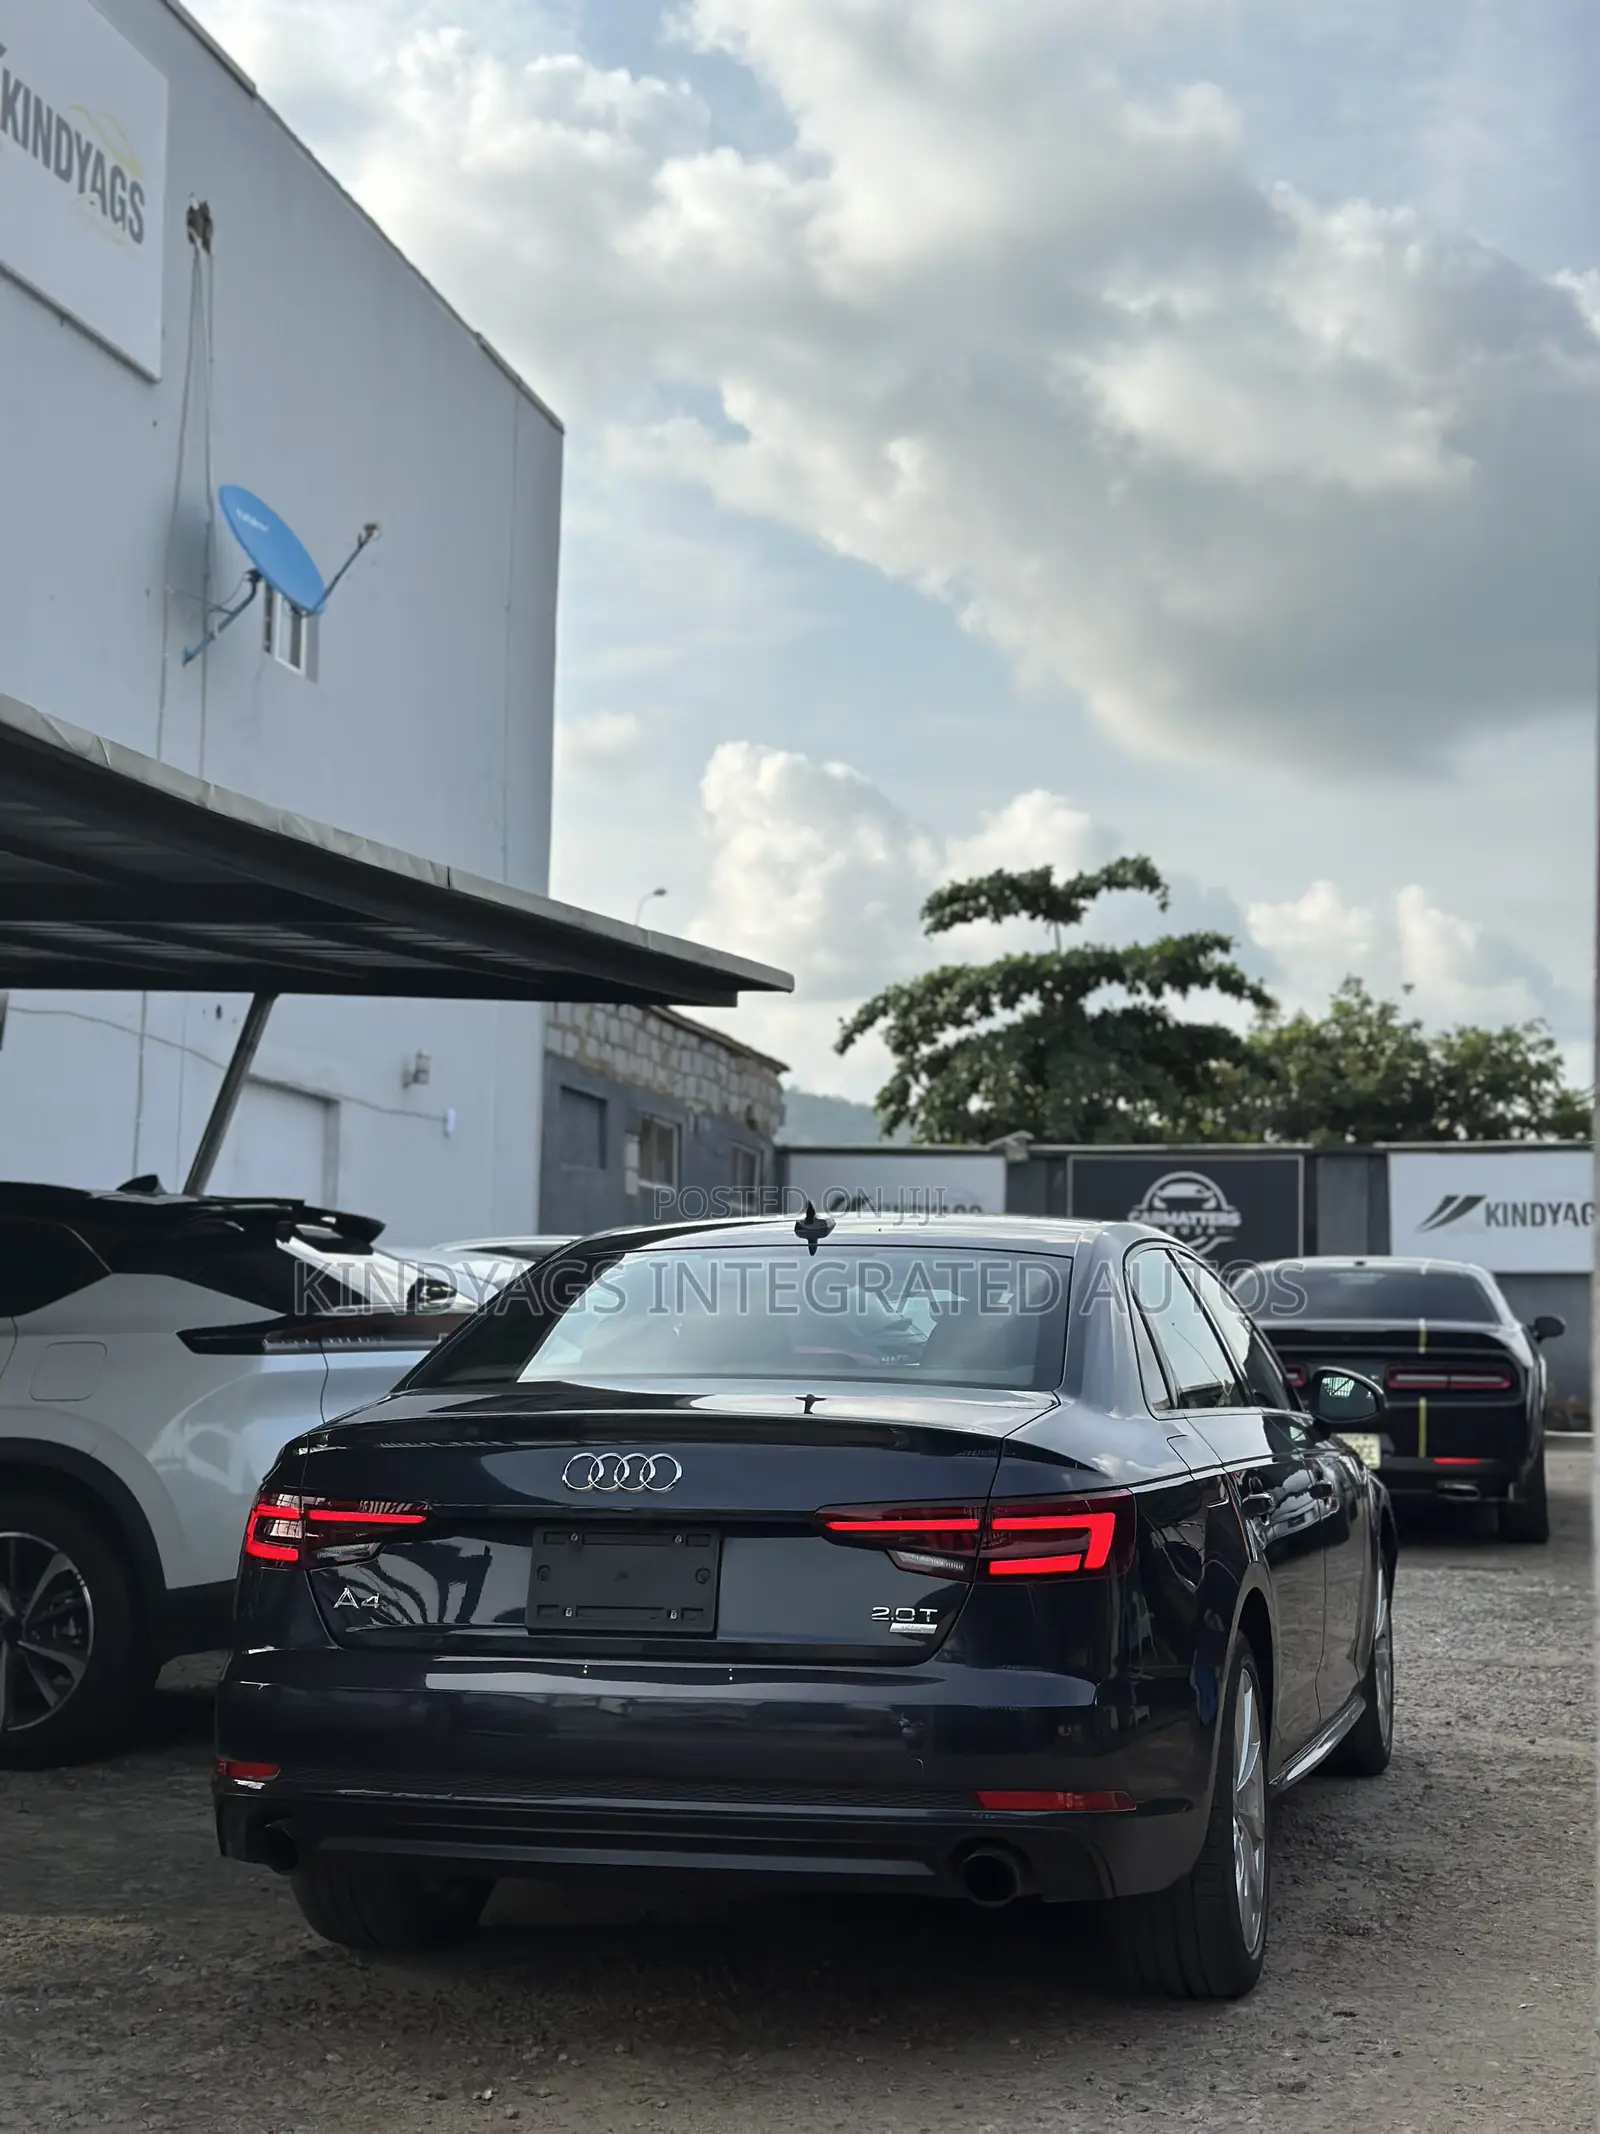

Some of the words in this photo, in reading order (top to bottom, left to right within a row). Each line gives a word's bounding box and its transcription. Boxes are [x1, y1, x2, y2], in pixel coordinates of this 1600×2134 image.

[0, 66, 145, 245] KINDYAGS
[333, 1587, 380, 1609] A4
[871, 1606, 938, 1623] 2.0T
